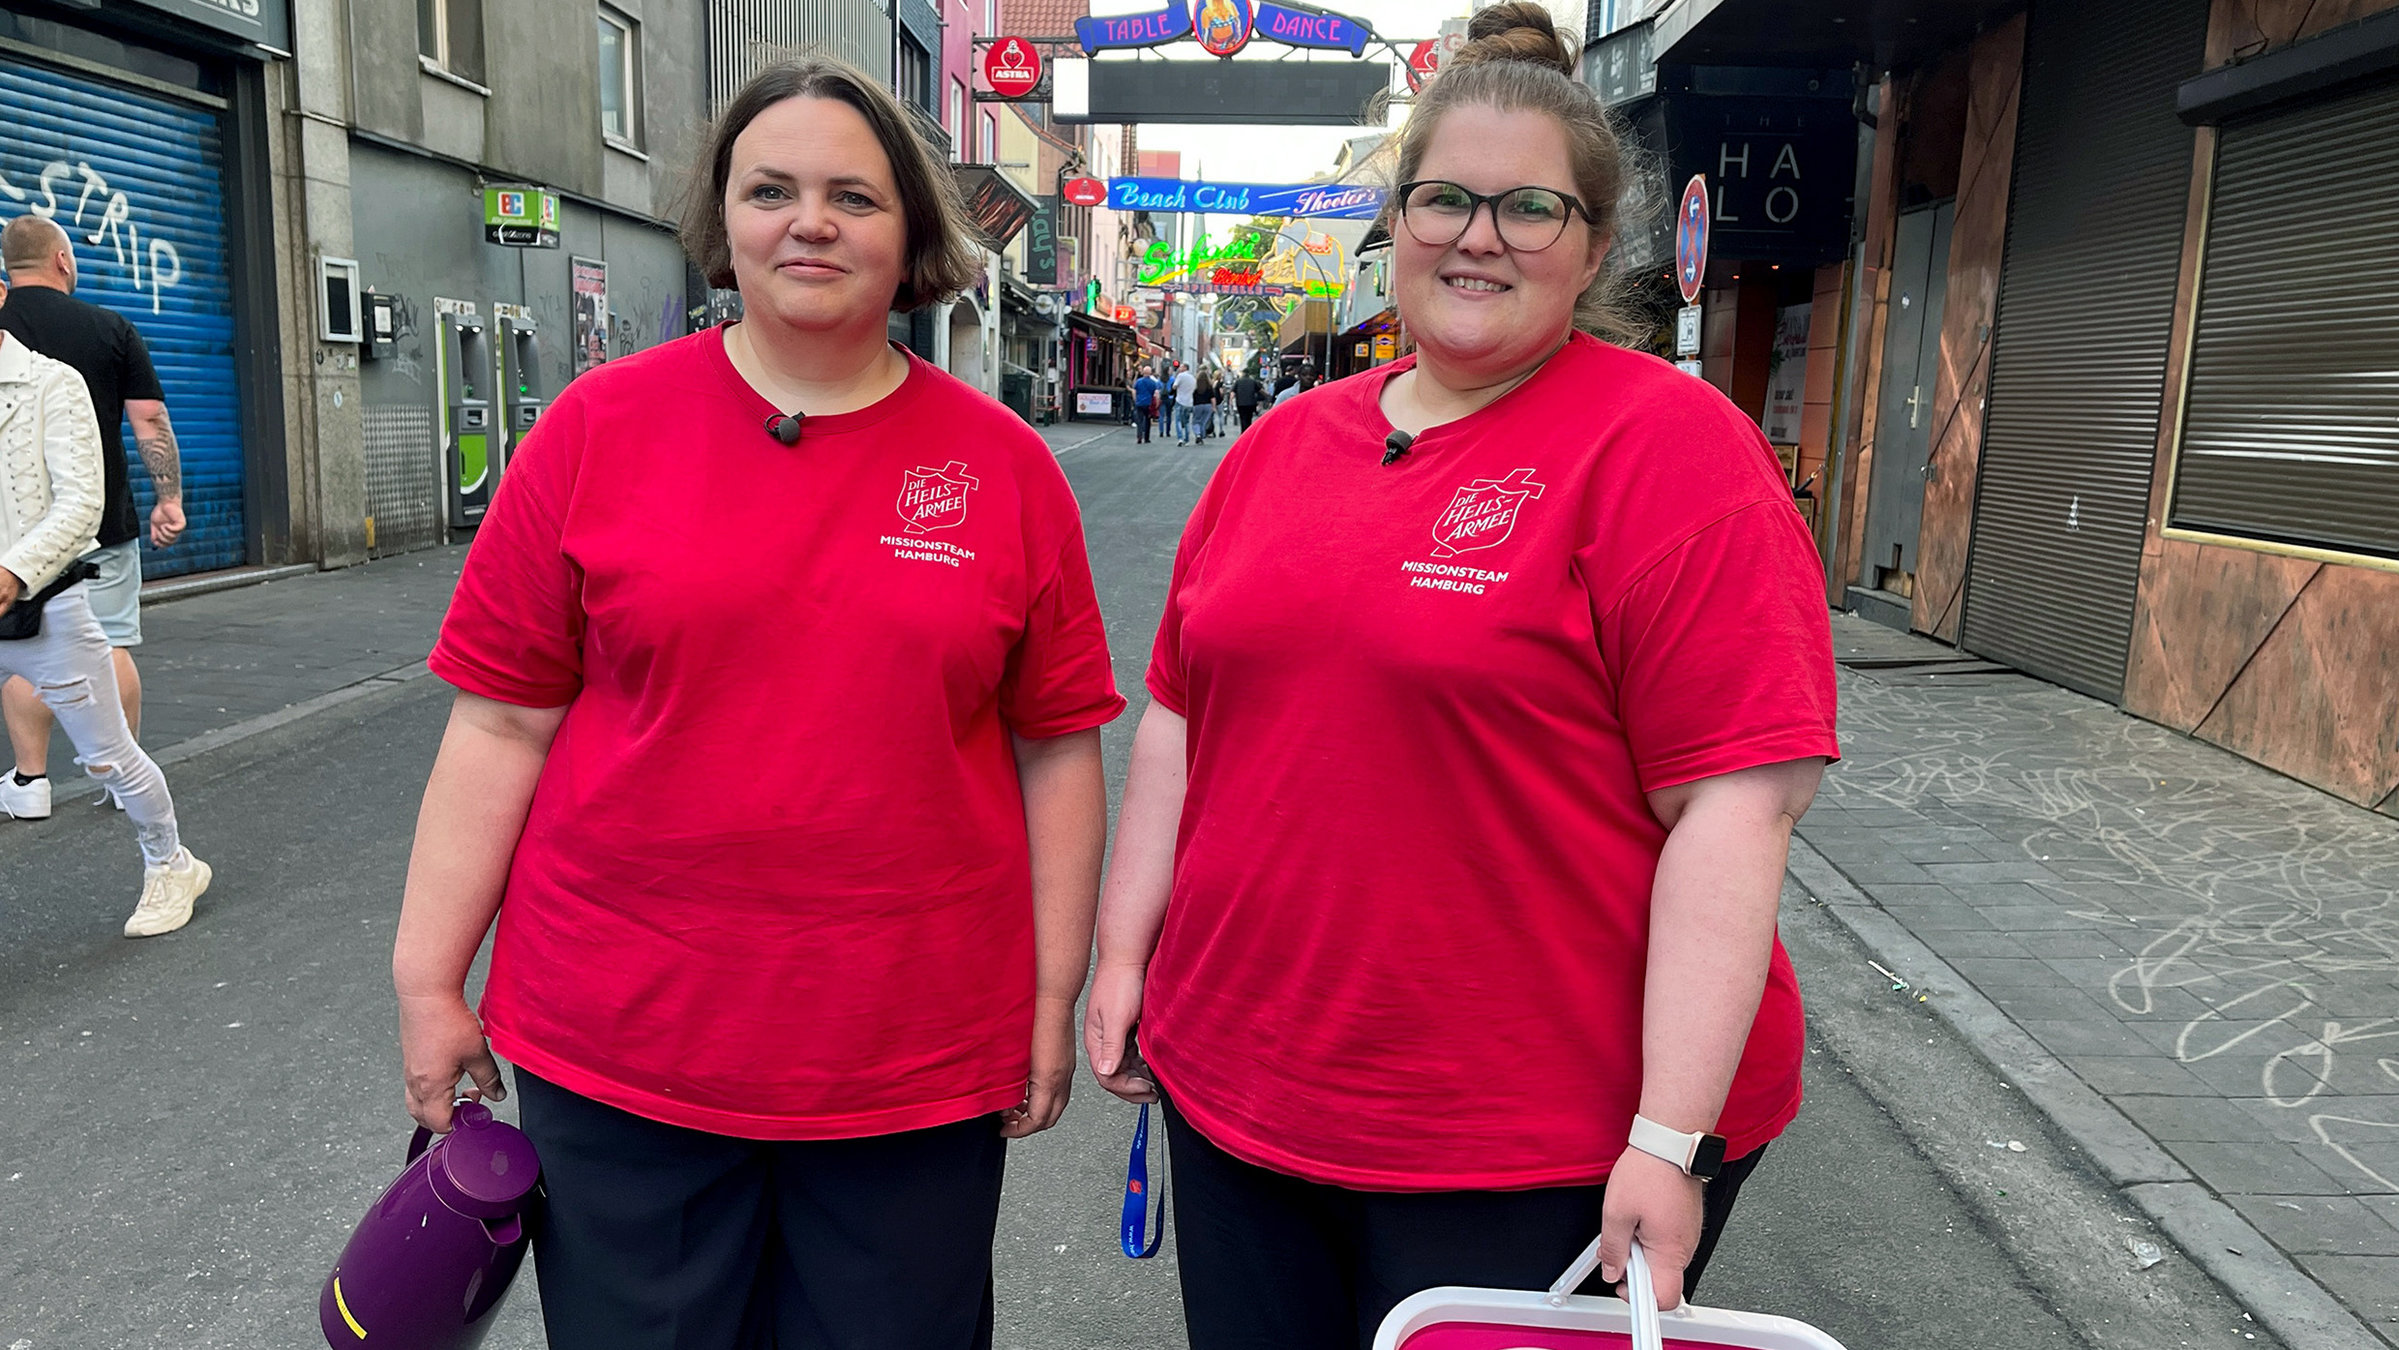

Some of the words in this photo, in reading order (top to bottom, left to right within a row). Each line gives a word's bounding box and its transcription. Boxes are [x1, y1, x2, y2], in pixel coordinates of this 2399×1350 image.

[1105, 13, 1172, 41] TABLE
[1272, 12, 1341, 41] DANCE
[995, 70, 1030, 79] ASTRA
[1115, 181, 1186, 209] Beach
[1193, 185, 1250, 211] Club
[1138, 231, 1261, 282] Safari
[905, 483, 959, 507] HEILS-
[907, 478, 927, 491] DIE
[911, 496, 963, 520] ARMEE
[1442, 495, 1514, 527] HEILS-
[1454, 492, 1479, 508] DIE
[1443, 509, 1514, 542] ARMEE
[880, 535, 975, 560] MISSIONSTEAM
[894, 549, 960, 567] HAMBURG
[1401, 560, 1509, 582] MISSIONSTEAM
[1410, 576, 1485, 595] HAMBURG
